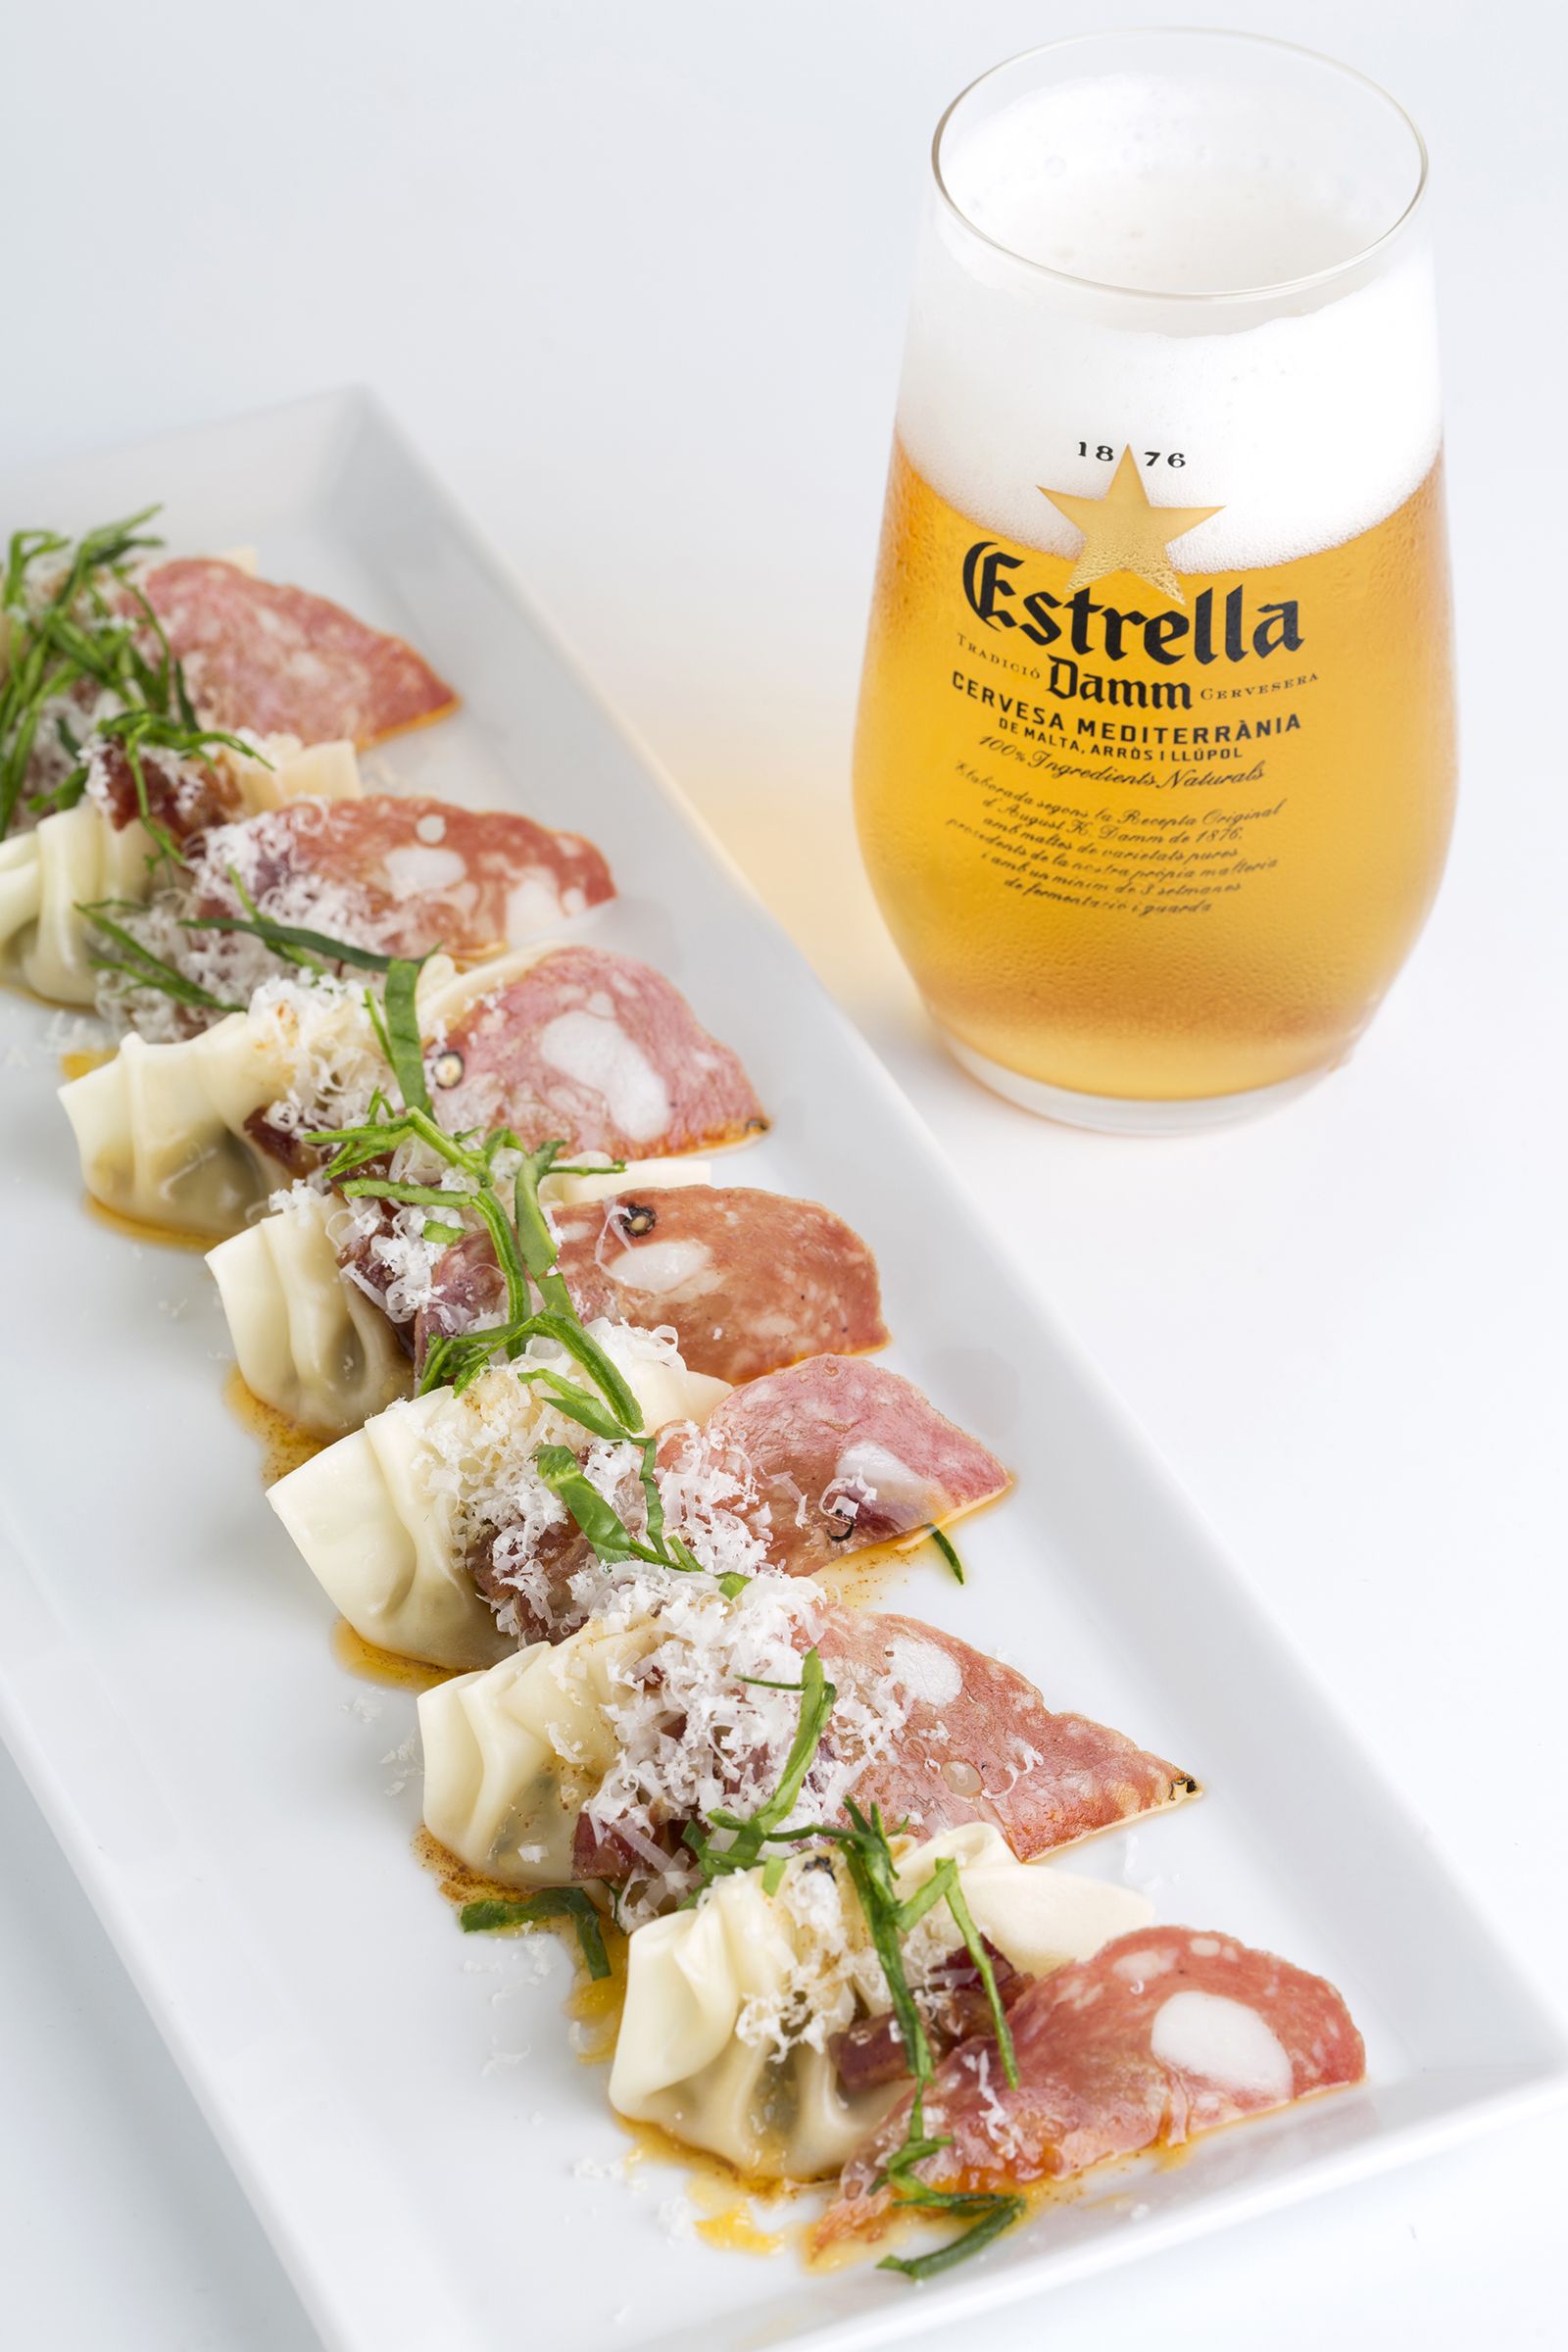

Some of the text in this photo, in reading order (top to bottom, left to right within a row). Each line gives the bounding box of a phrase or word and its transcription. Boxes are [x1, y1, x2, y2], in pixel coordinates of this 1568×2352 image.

[962, 541, 1305, 665] Estrella
[953, 670, 1301, 745] CERVESA MEDITERRÀNIA
[1046, 654, 1193, 710] Damm
[978, 736, 1266, 789] 100% Ingredients Naturals
[999, 717, 1018, 734] DE
[1024, 727, 1085, 755] MALTA,
[1090, 744, 1152, 760] ARRÒS
[1171, 747, 1243, 761] LLÚPOL
[956, 759, 1288, 830] Elaborada segons la Recepta Original
[983, 816, 1024, 834] amb
[1077, 842, 1098, 856] de
[1098, 824, 1163, 844] Damm
[1168, 830, 1190, 844] de
